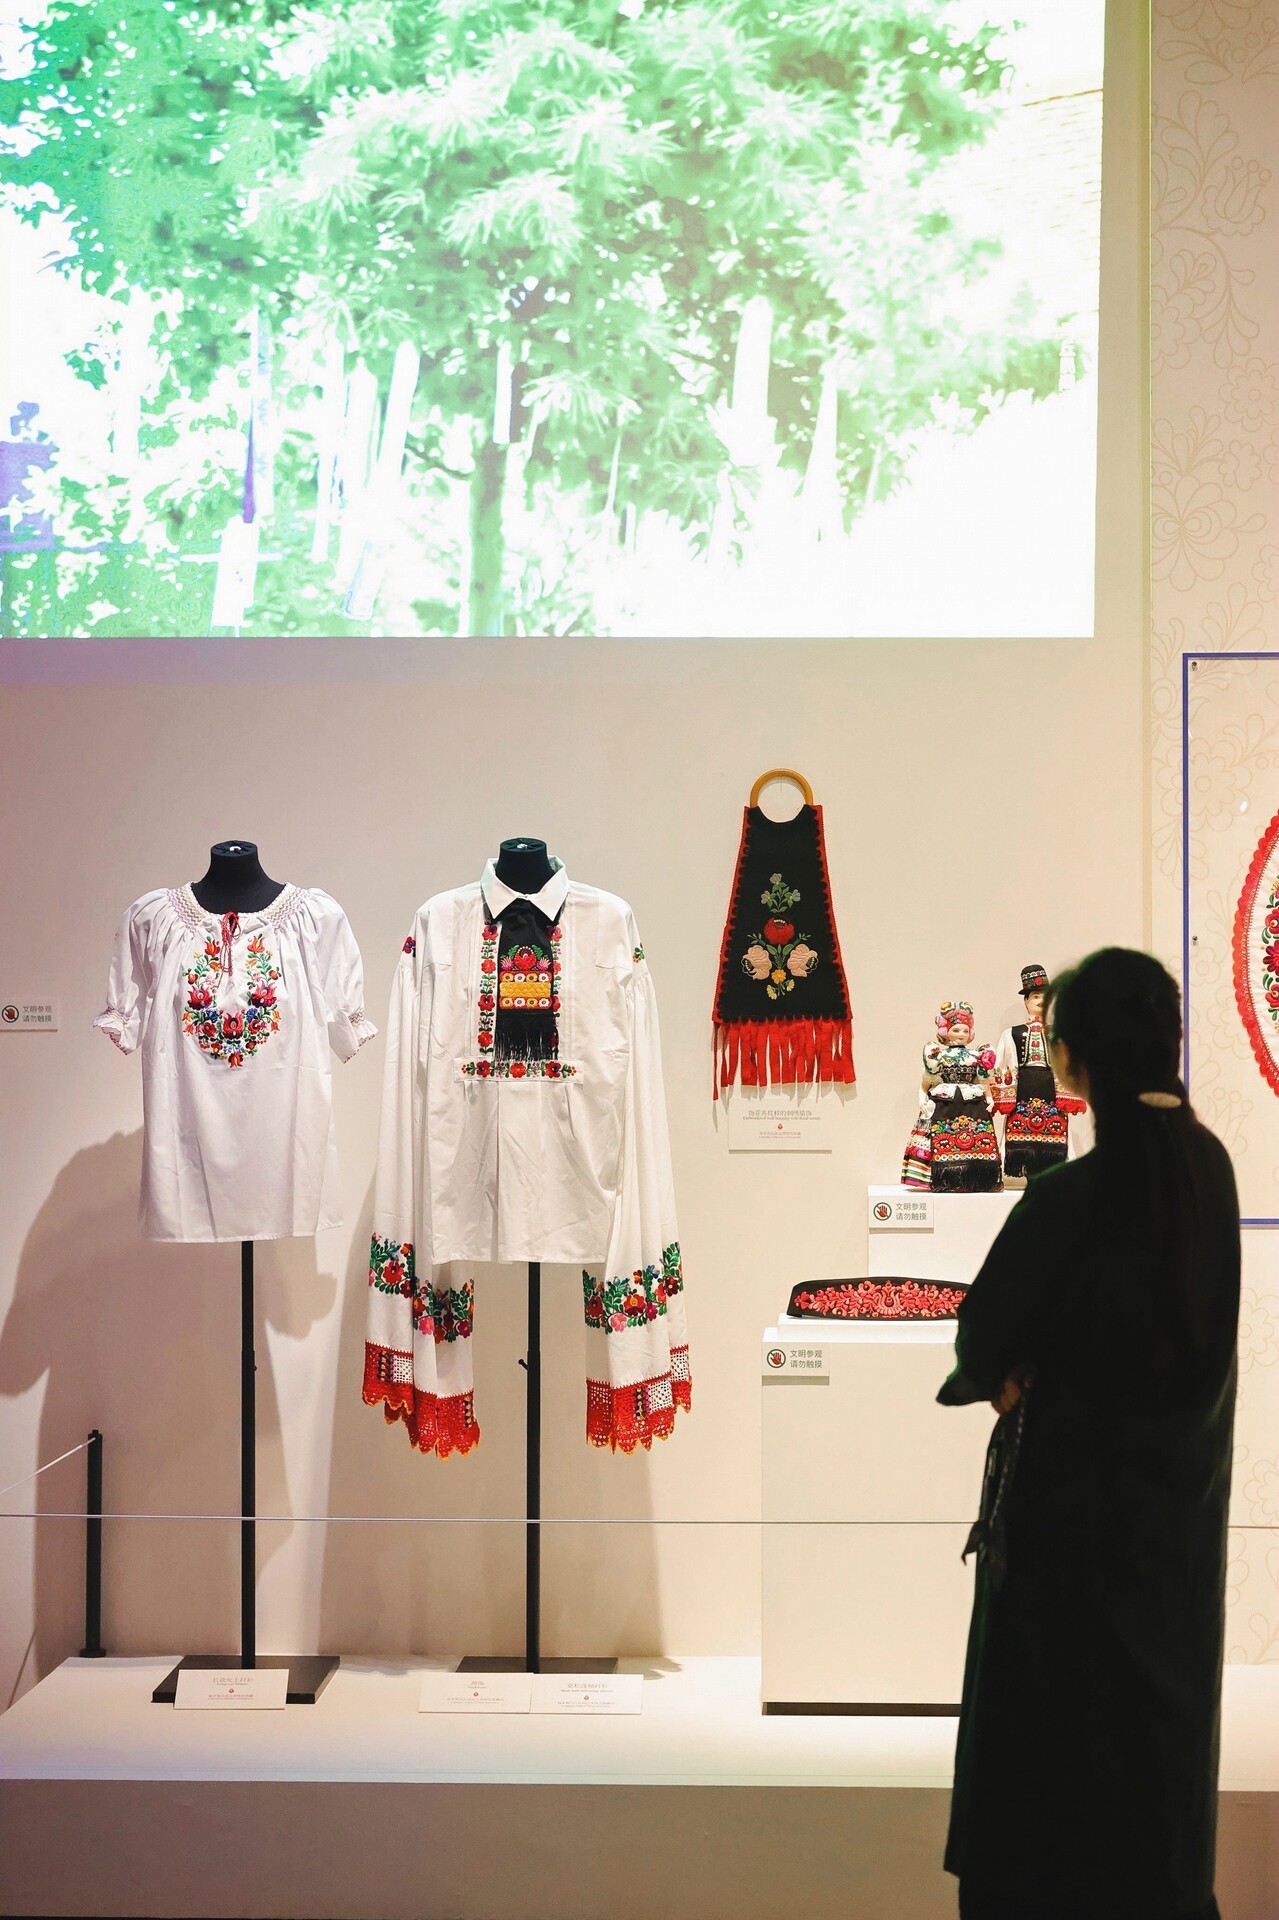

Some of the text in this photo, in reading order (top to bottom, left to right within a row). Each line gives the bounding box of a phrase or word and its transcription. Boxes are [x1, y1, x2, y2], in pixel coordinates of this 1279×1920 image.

[895, 1202, 927, 1211] 文明参观
[895, 1212, 927, 1221] 请勿触摸
[790, 1349, 823, 1358] 文明参观
[790, 1360, 823, 1369] 请勿触摸
